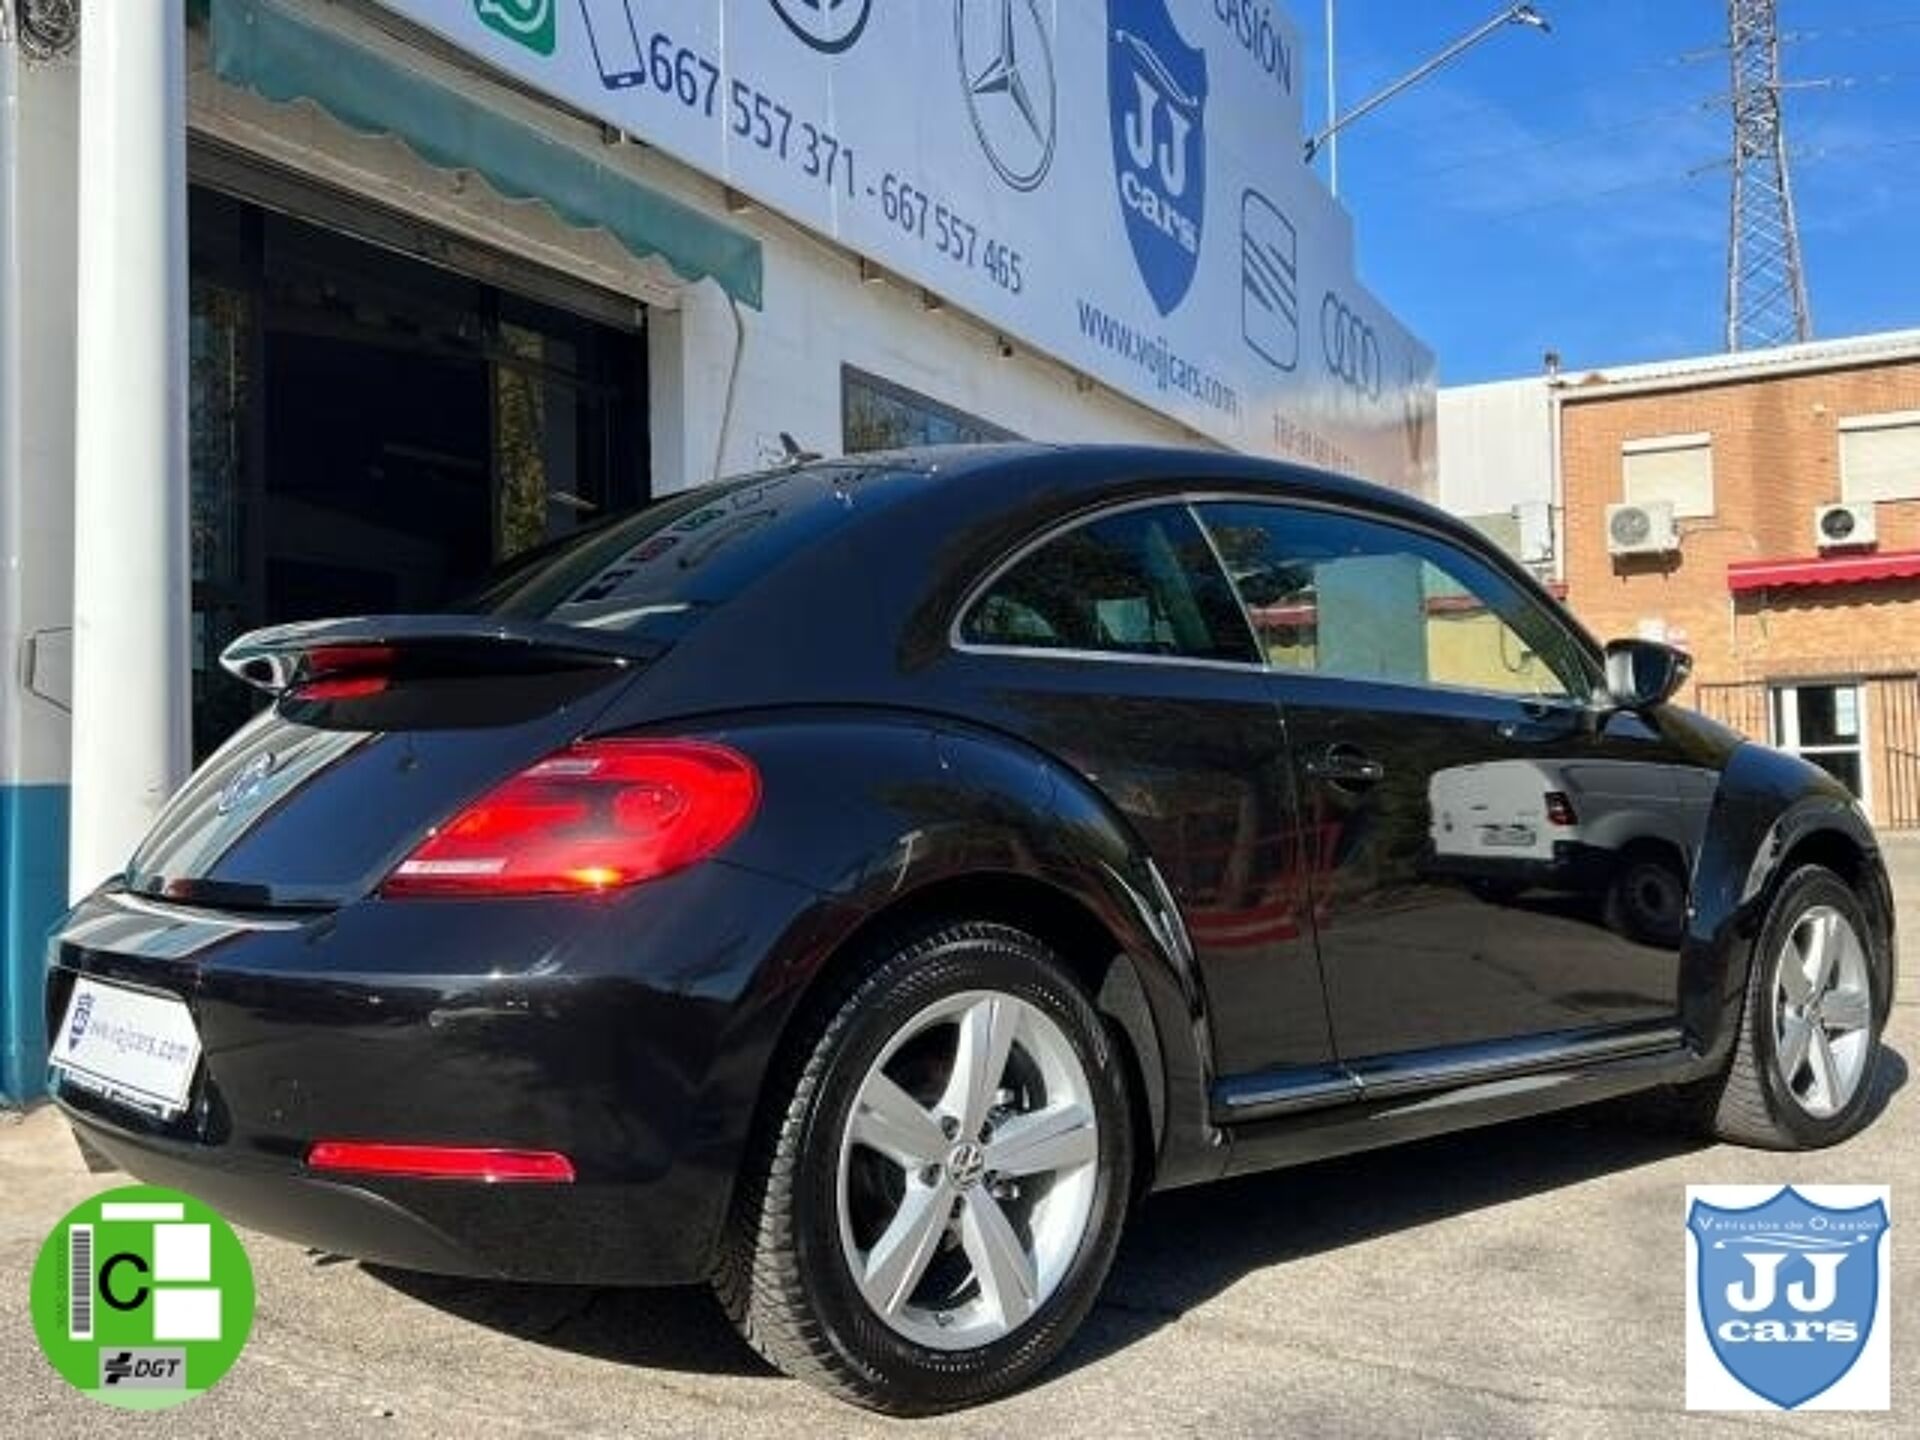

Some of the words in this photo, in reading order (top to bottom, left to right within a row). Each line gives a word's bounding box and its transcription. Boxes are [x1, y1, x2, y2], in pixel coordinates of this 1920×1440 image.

[650, 33, 720, 117] 667
[732, 78, 793, 160] 557
[803, 122, 854, 198] 371
[881, 173, 928, 241] 667
[935, 204, 976, 267] 557
[984, 239, 1021, 294] 465
[1125, 71, 1190, 196] JJ
[1121, 171, 1199, 256] cars
